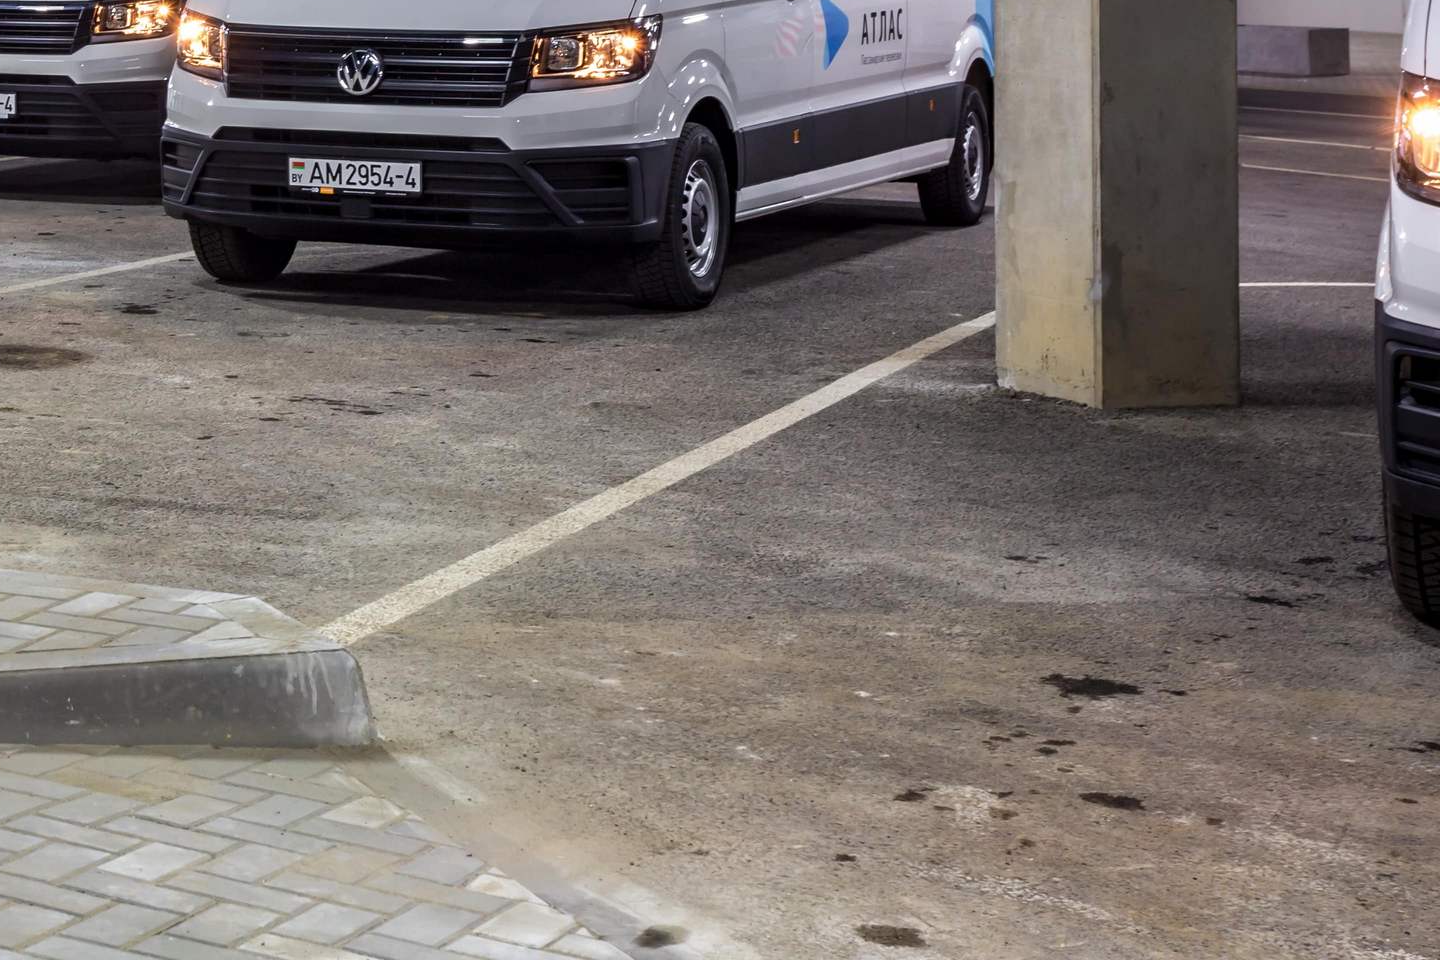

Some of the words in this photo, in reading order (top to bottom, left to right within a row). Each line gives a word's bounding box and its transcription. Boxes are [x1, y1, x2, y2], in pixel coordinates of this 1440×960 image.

[860, 7, 903, 45] АТЛАС
[291, 173, 303, 183] BY
[308, 161, 417, 189] AM2954-4
